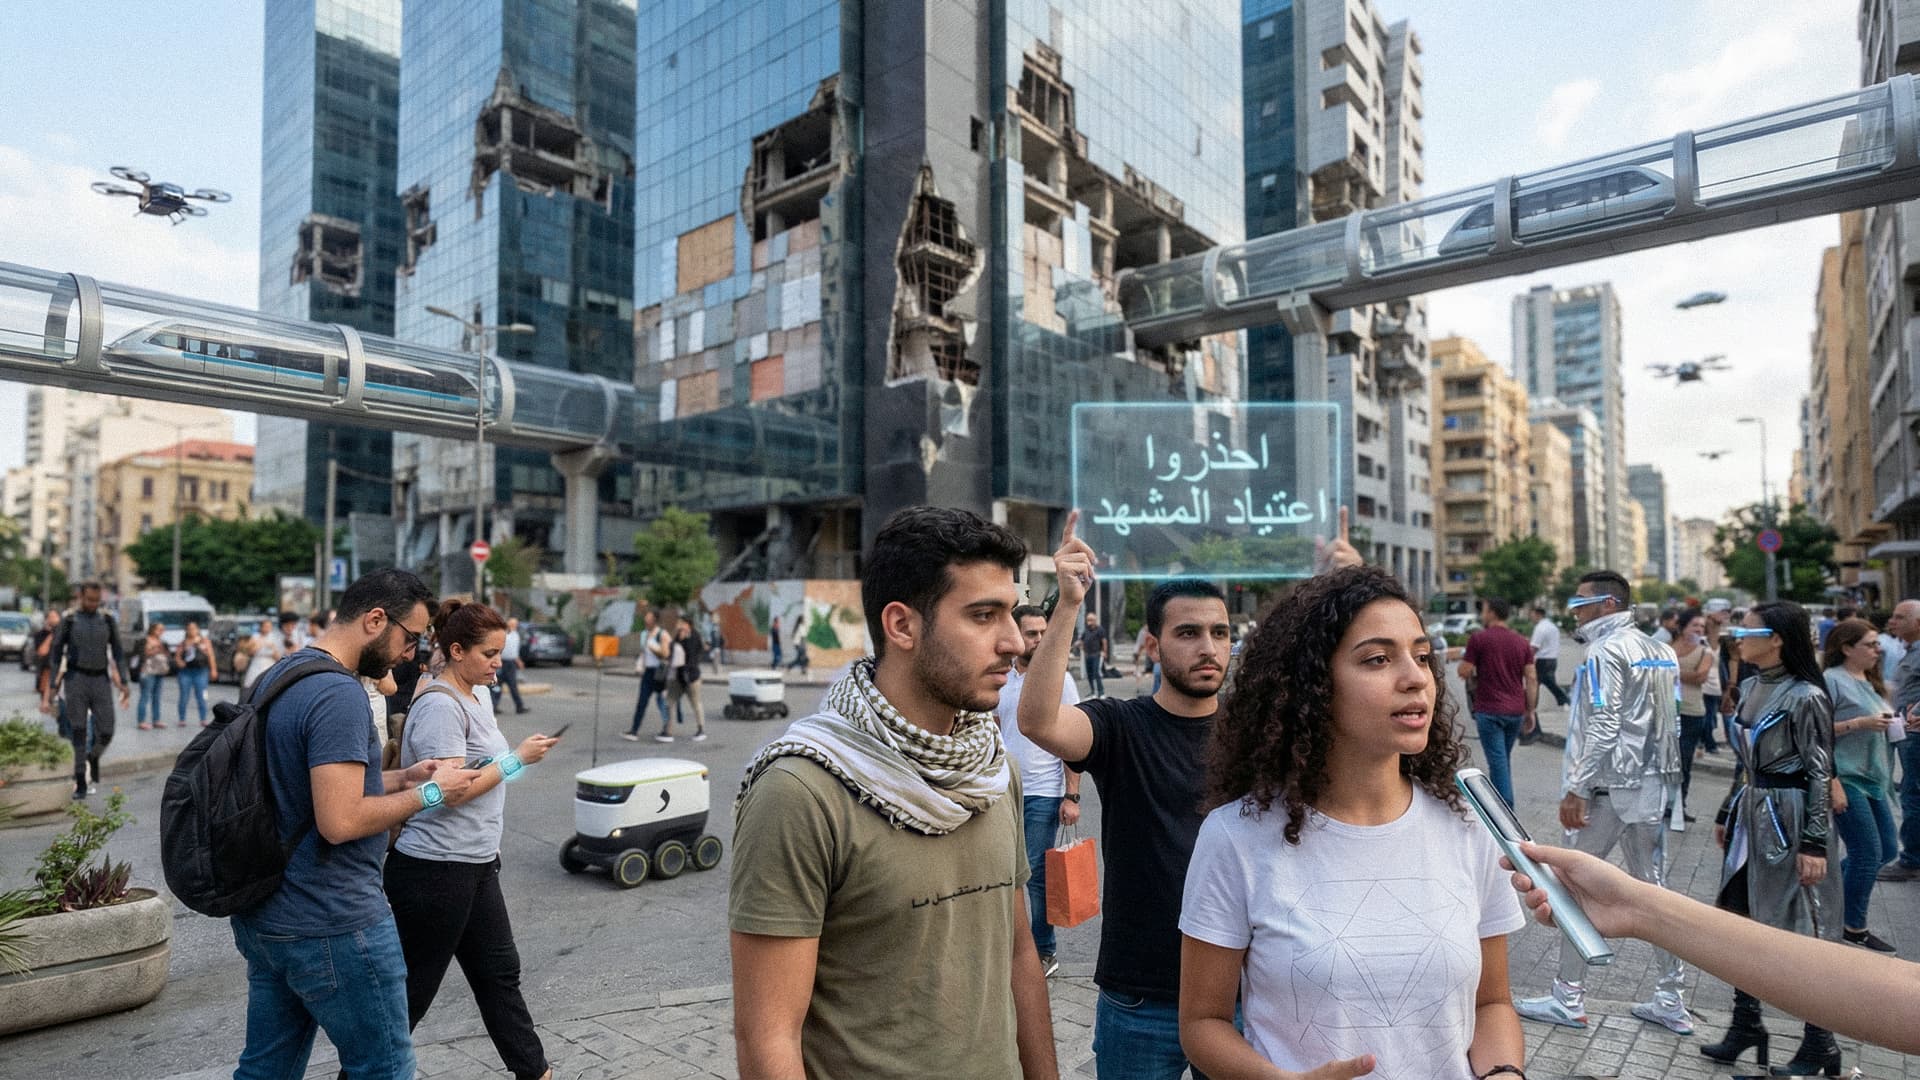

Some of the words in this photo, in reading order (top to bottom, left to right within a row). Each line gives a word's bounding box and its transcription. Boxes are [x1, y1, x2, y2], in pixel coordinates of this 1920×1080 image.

[1145, 431, 1269, 482] احذروا
[1093, 487, 1211, 536] المشهد
[1225, 487, 1327, 536] اعتياد
[911, 897, 930, 909] ما
[932, 885, 982, 906] مستقبل
